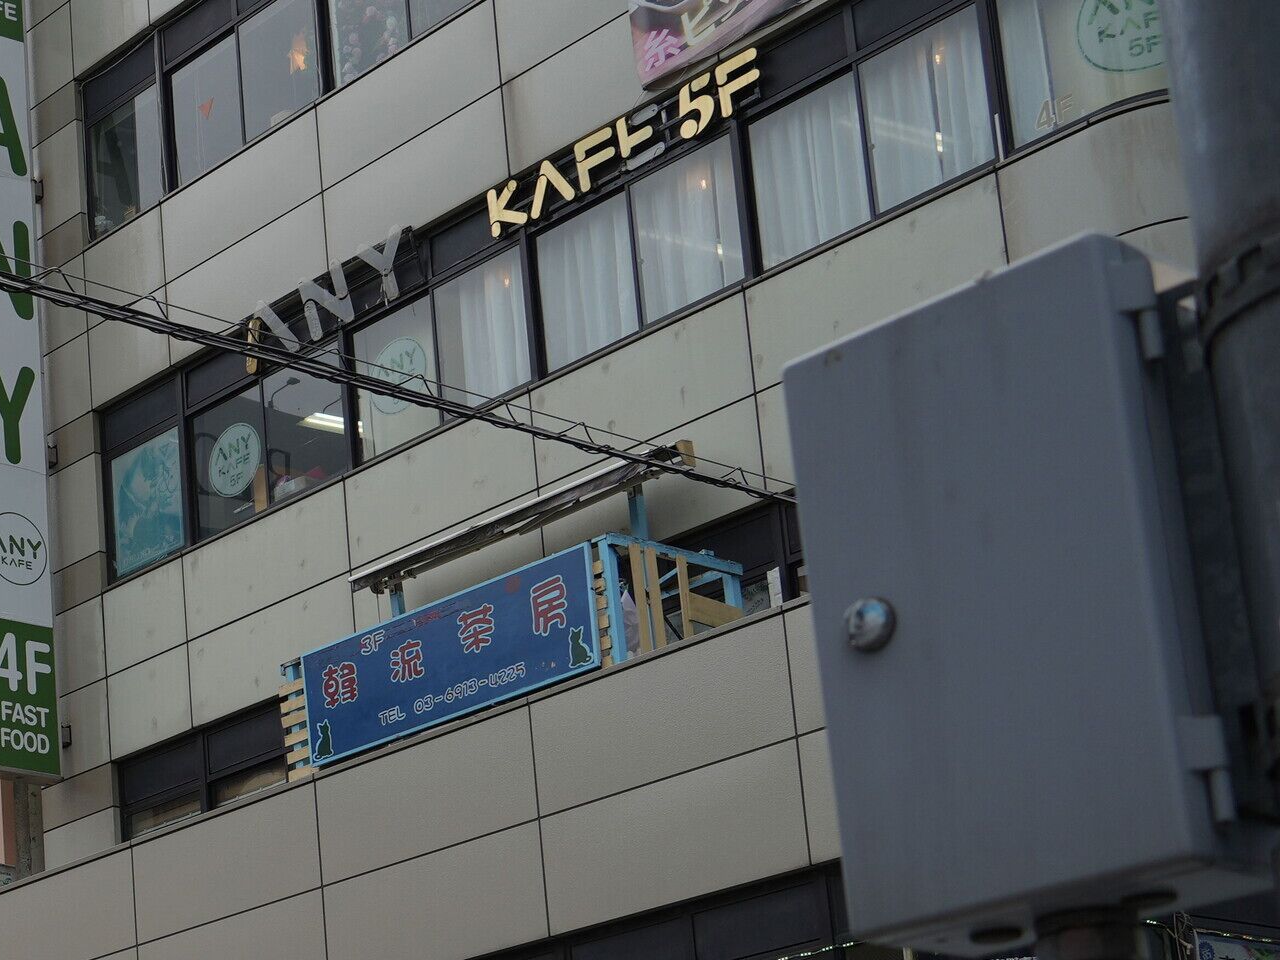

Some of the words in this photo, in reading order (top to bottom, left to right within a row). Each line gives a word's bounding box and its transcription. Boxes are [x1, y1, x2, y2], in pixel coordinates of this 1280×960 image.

[678, 47, 760, 139] 5F
[1, 555, 33, 571] KAFE
[322, 574, 568, 709] 韓流茶房
[360, 630, 384, 655] 3F
[1, 699, 49, 728] FAST
[378, 705, 406, 727] TEL
[0, 726, 50, 755] FOOD
